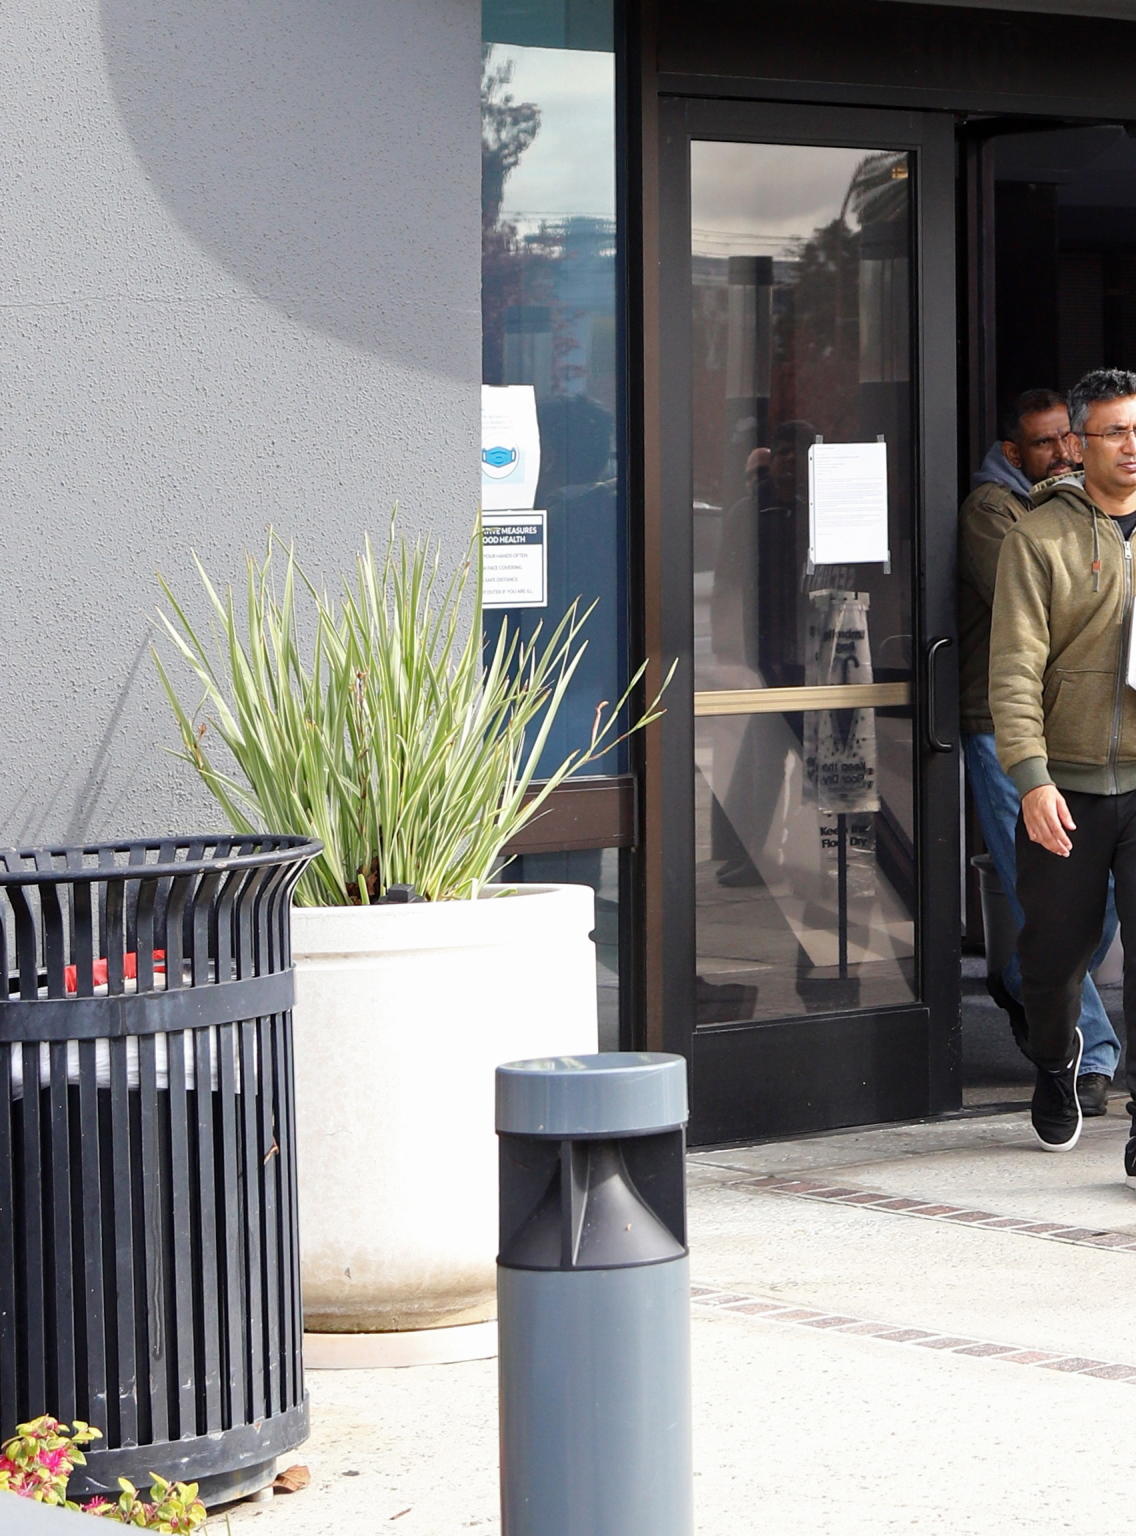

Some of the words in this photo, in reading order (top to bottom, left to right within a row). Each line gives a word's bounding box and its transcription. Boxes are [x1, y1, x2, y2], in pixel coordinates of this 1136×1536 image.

[501, 526, 537, 535] MEASURES
[483, 536, 499, 544] OOD
[499, 535, 526, 543] HEALTH
